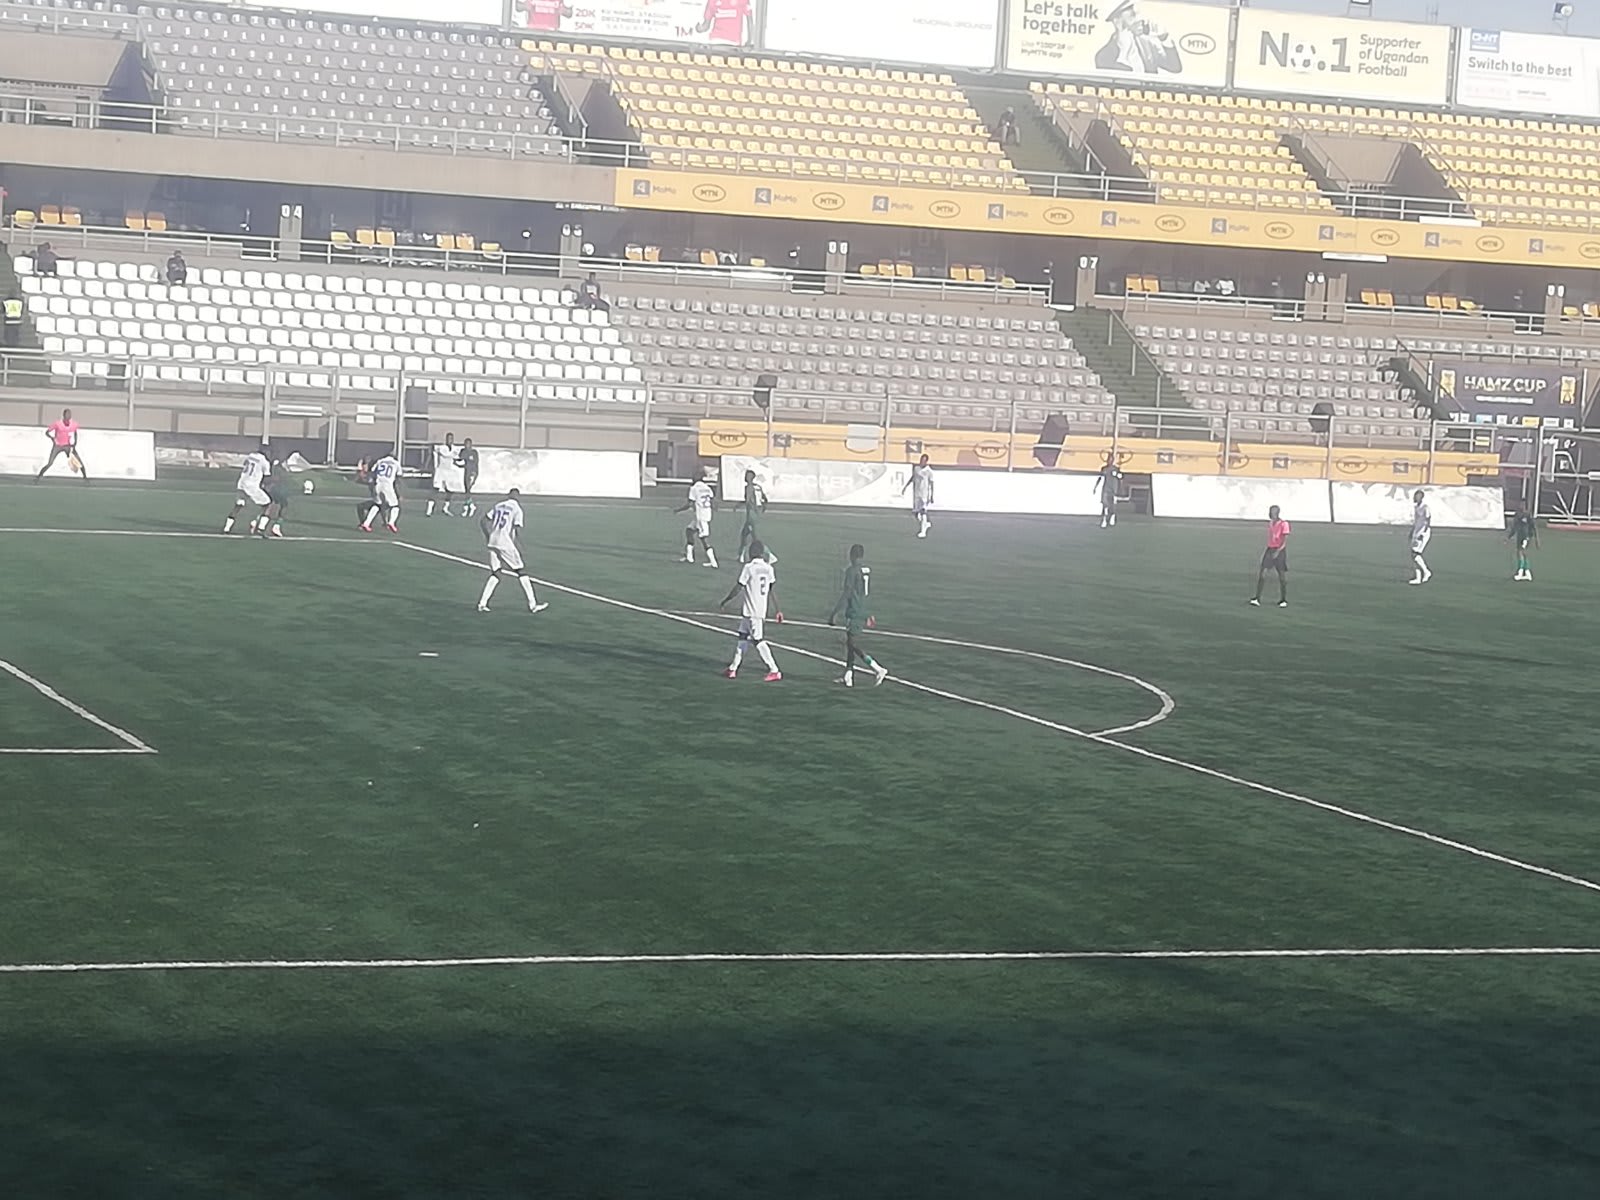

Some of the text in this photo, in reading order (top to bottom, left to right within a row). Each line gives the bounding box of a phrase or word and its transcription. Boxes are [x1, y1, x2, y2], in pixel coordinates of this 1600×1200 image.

[1024, 0, 1099, 19] Let's talk
[1023, 16, 1095, 35] together
[1188, 39, 1208, 48] MTN
[1360, 33, 1422, 49] Supporter
[1358, 47, 1429, 64] of Ugandan
[1357, 63, 1408, 77] Football
[1468, 56, 1509, 72] Switch
[1511, 61, 1524, 73] to
[1526, 62, 1545, 75] the
[1547, 63, 1573, 77] best
[1080, 256, 1099, 269] 07
[1464, 375, 1547, 393] HAMZ CUP
[378, 464, 393, 478] 20
[780, 473, 853, 491] SOCCER
[494, 509, 510, 530] 15
